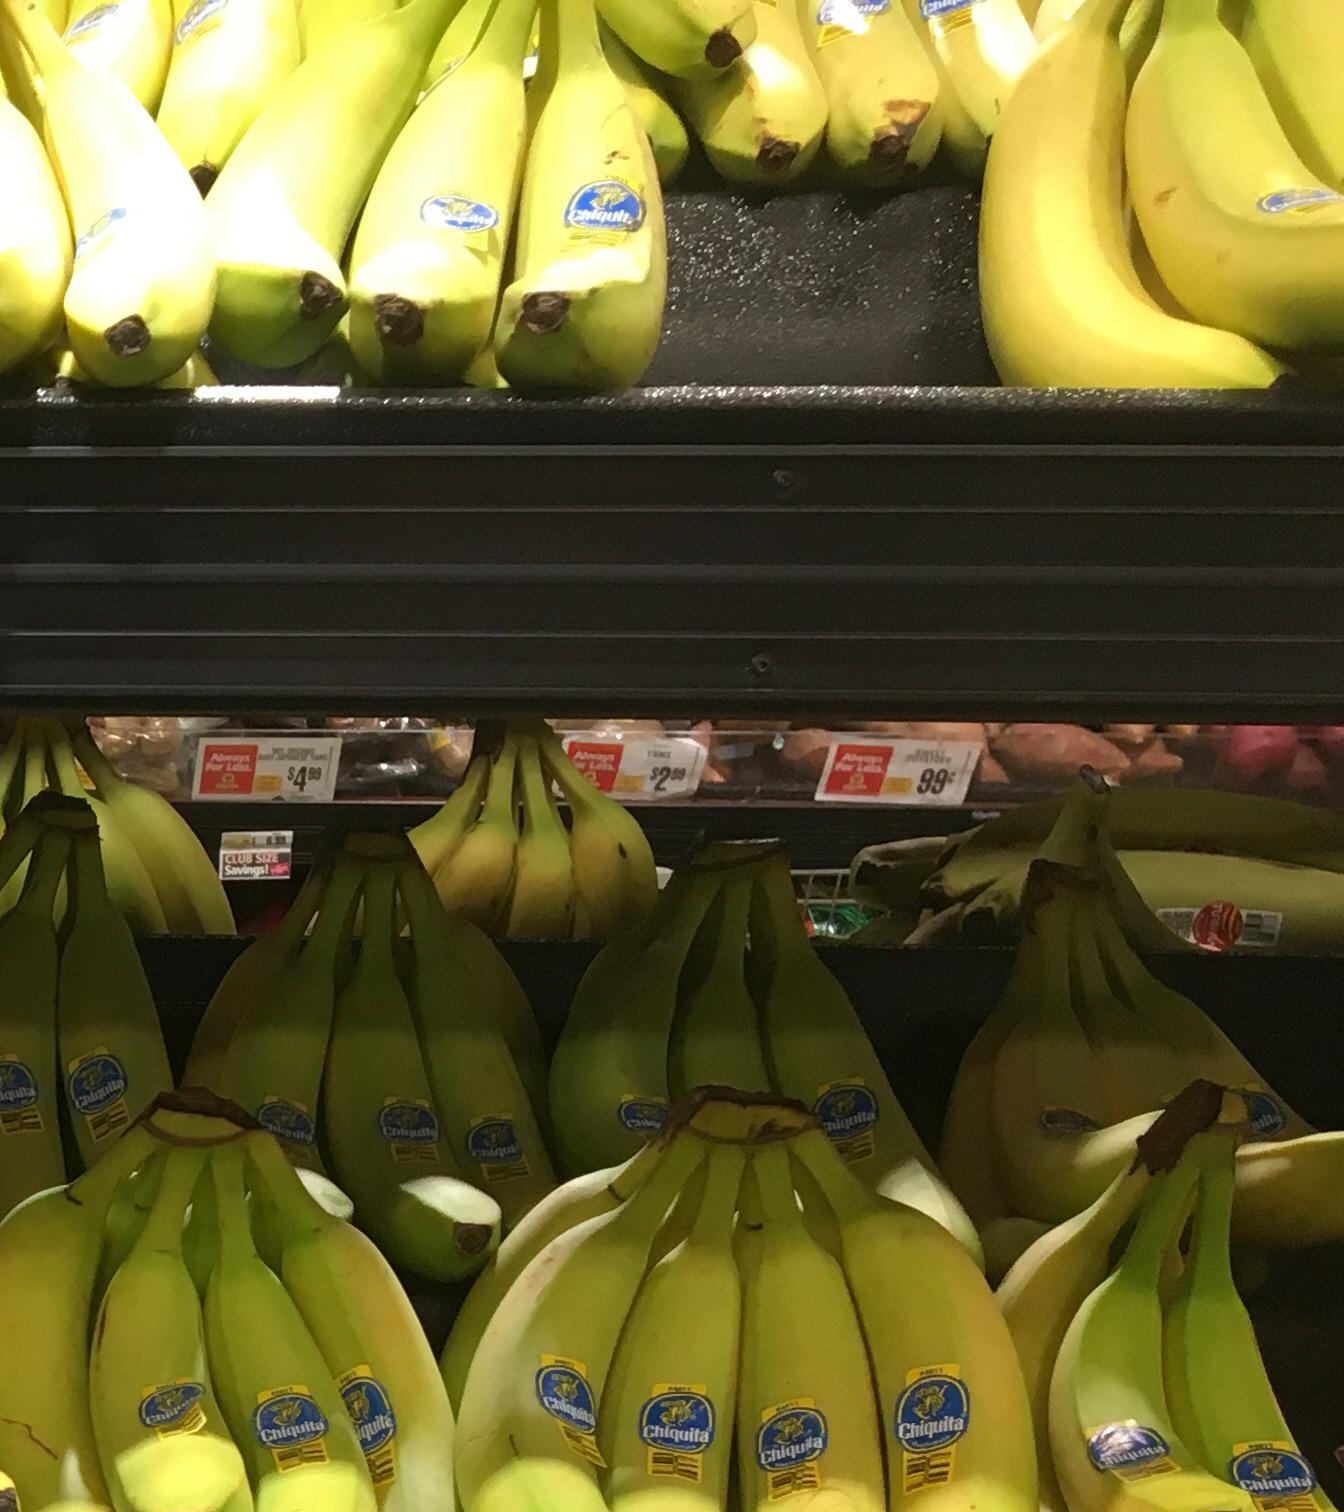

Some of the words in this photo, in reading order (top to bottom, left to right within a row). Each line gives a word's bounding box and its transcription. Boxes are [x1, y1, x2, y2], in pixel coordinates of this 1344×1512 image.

[224, 853, 253, 864] CLUB
[255, 853, 279, 864] SIZE
[224, 864, 269, 878] Savings!
[75, 1079, 125, 1108] Chiquita
[383, 1125, 438, 1138] Chiquita
[543, 1397, 595, 1423] Chiquita
[261, 1421, 325, 1442] Chiquita
[357, 1415, 393, 1441] iquita
[643, 1425, 709, 1442] Chiquita
[898, 1417, 964, 1440] Chiquita
[760, 1436, 823, 1463] Chiquita
[1240, 1478, 1312, 1491] Chiquita
